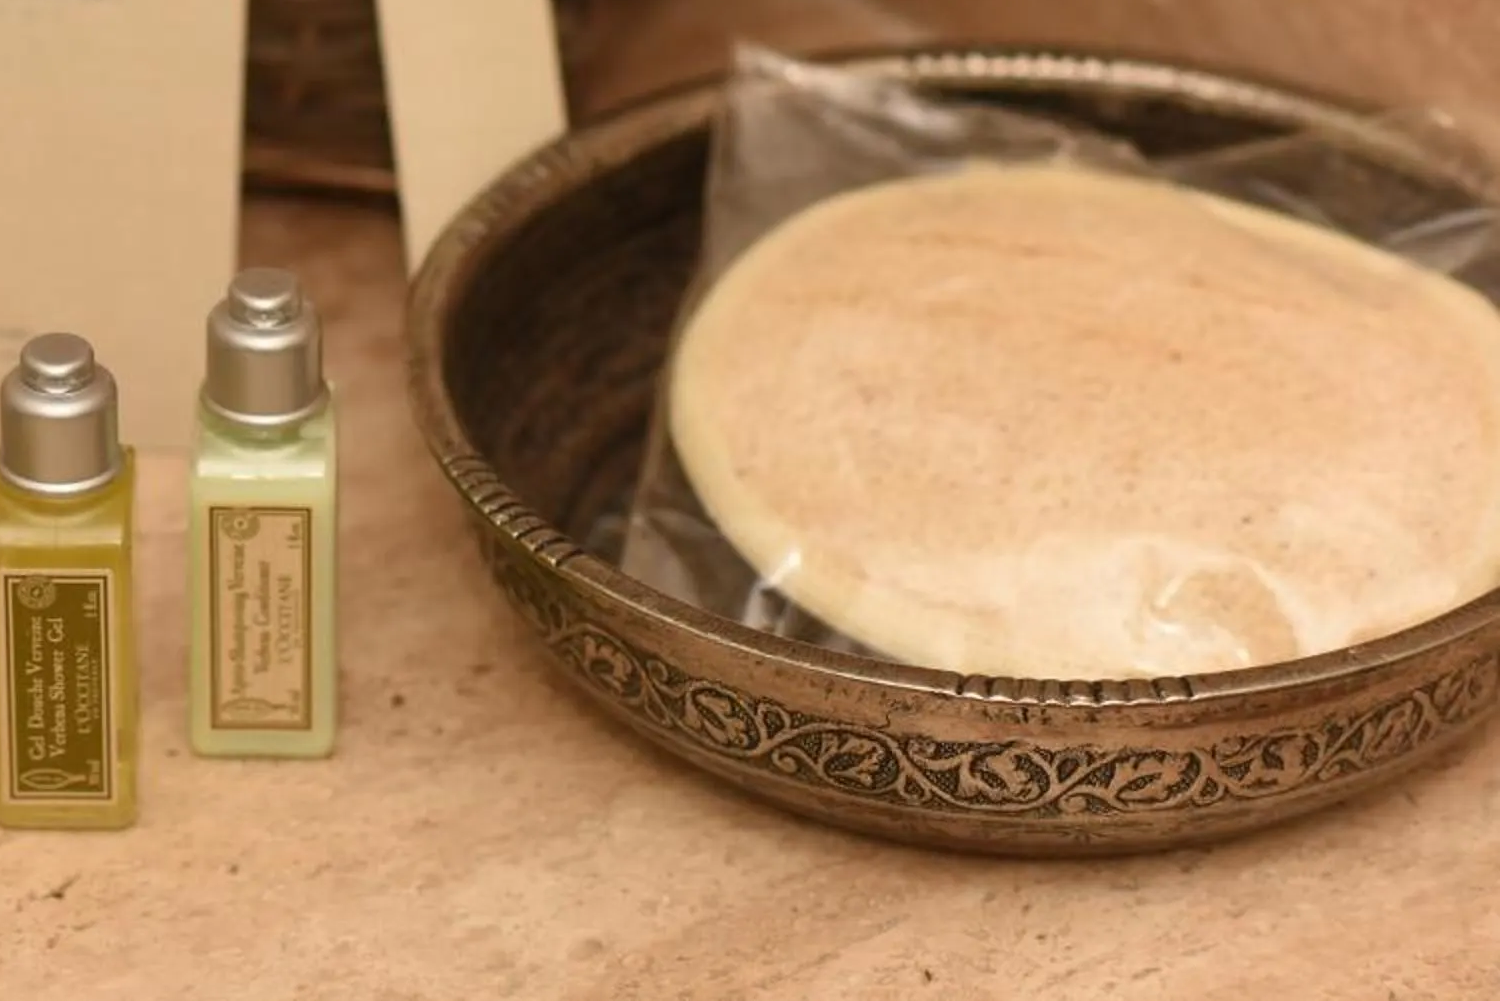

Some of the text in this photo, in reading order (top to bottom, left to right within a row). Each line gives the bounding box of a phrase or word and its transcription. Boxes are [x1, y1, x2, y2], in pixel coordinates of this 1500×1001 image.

[27, 678, 45, 729] Douche
[46, 617, 67, 758] Verbena Shower Gel
[29, 735, 46, 761] Gel
